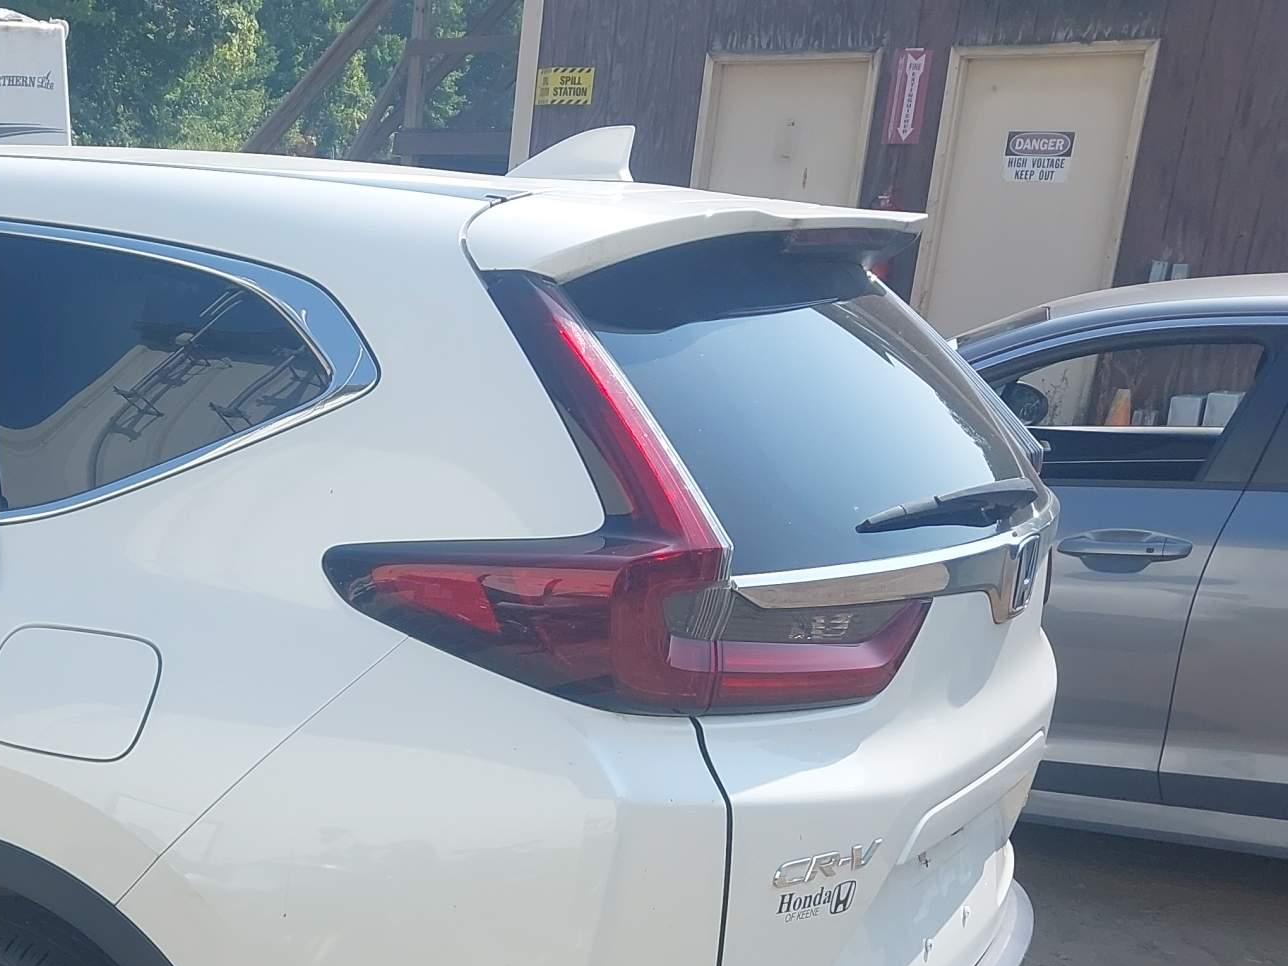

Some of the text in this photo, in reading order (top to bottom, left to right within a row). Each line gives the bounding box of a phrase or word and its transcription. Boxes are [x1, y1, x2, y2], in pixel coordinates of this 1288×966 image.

[559, 75, 582, 85] SPILL
[552, 86, 588, 97] STATION
[1014, 138, 1065, 150] DANGER
[1007, 157, 1066, 168] HIGH VOLTAGE
[1015, 169, 1056, 180] KEEP OUT
[773, 837, 883, 888] CR-V
[776, 886, 832, 914] Honda
[784, 906, 820, 923] OF KEENE
